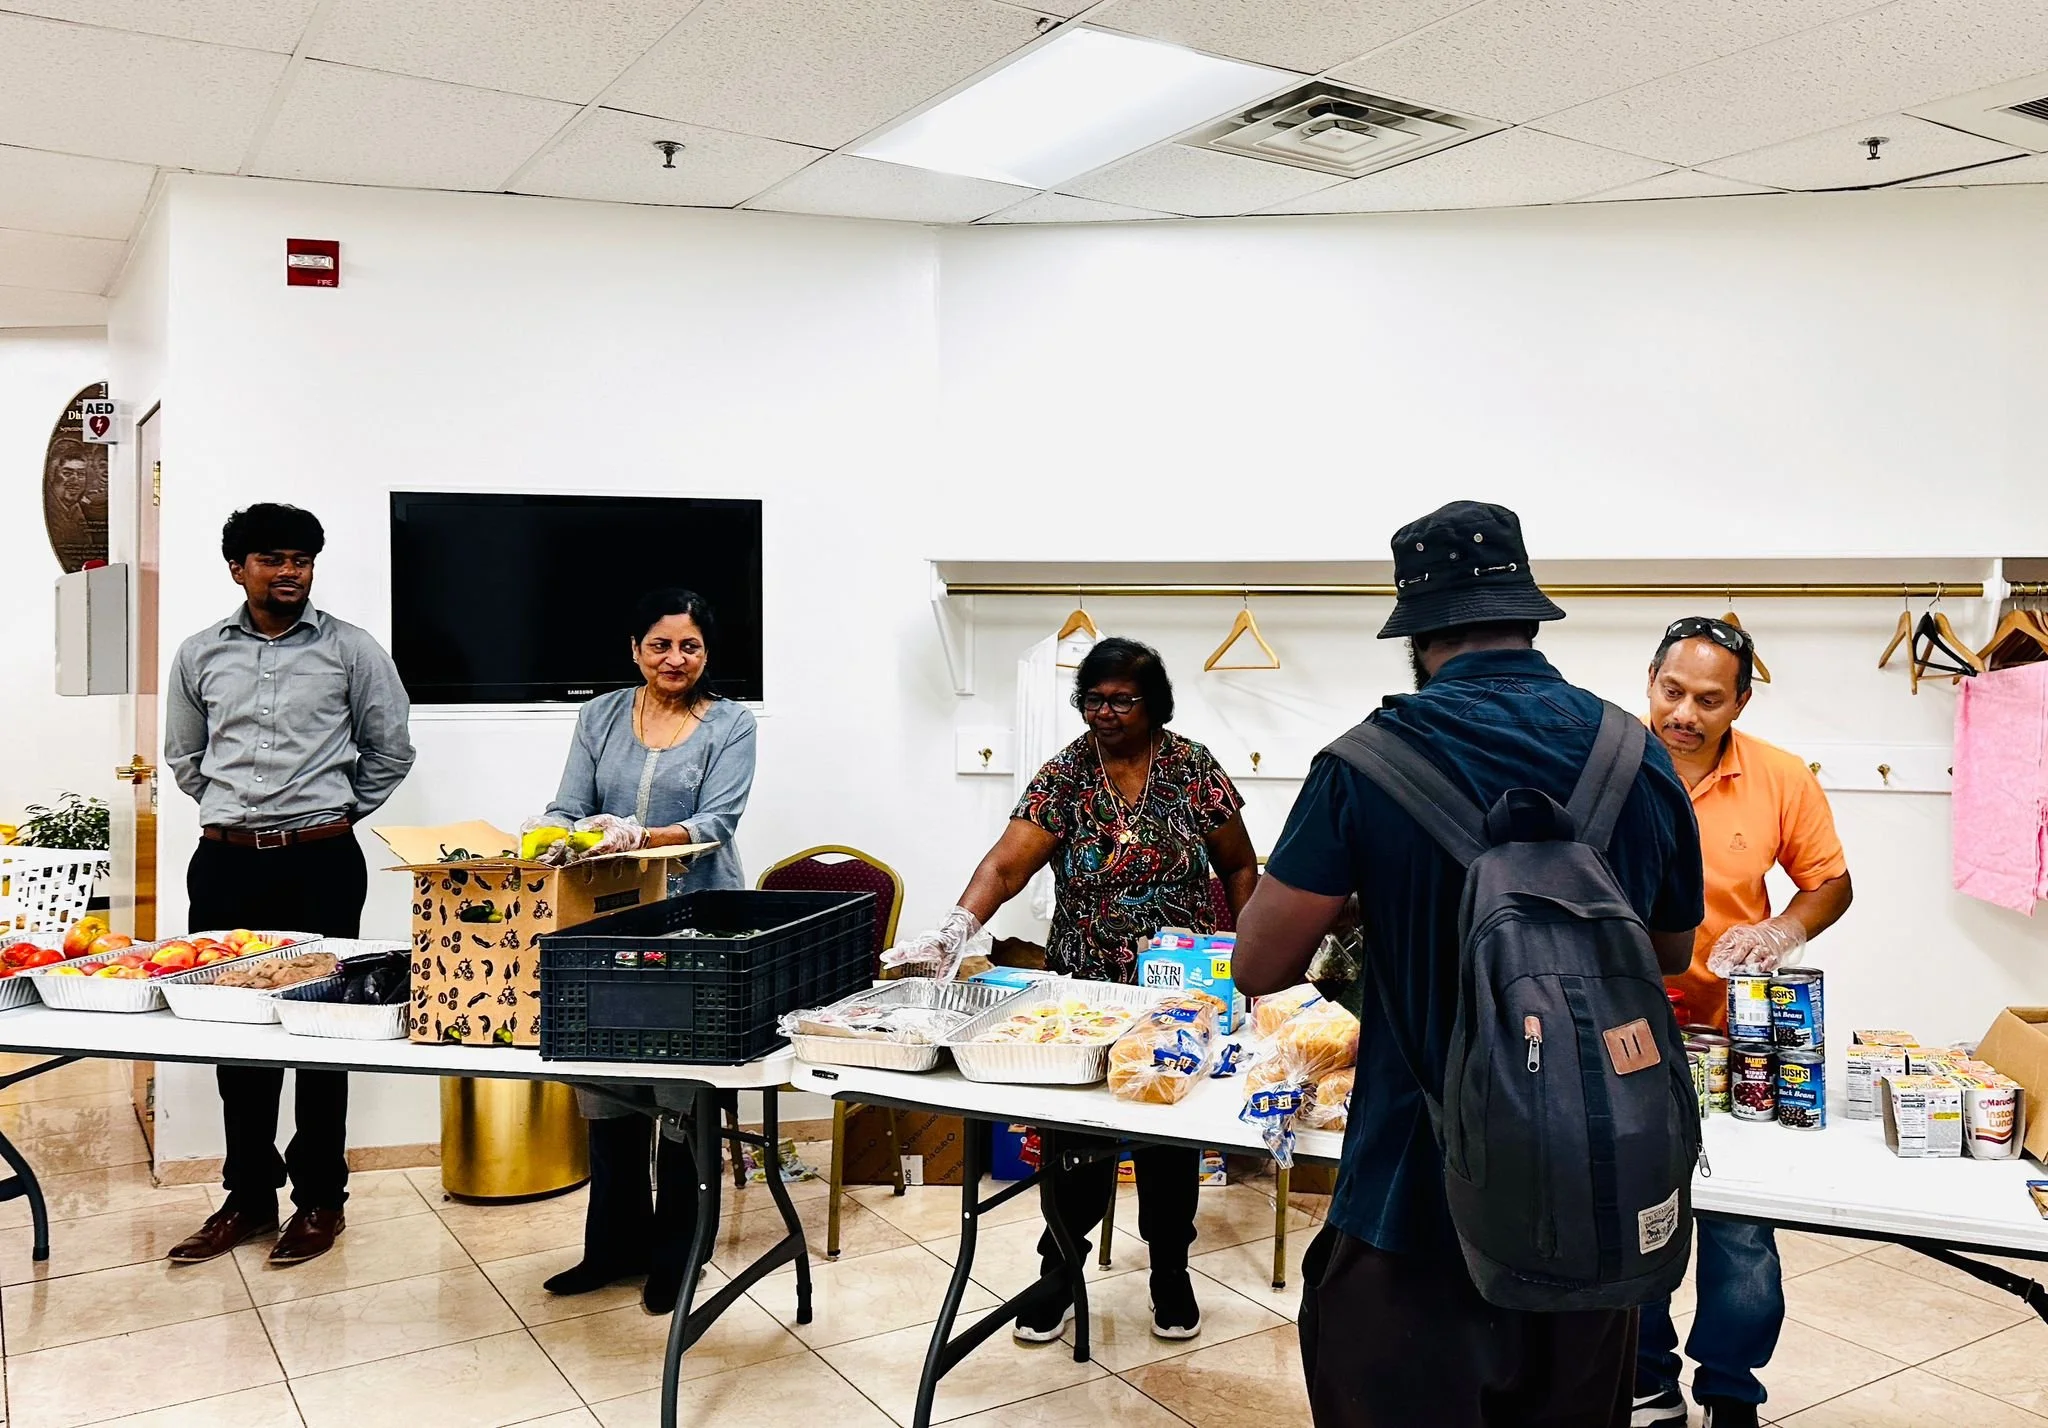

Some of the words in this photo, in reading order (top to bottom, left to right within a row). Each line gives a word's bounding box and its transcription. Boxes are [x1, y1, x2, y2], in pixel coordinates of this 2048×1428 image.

[85, 402, 115, 415] AED
[68, 410, 84, 420] Dhi
[1147, 964, 1181, 975] NUTRI
[1216, 963, 1225, 972] 12
[1147, 975, 1180, 986] GRAIN
[1780, 1066, 1809, 1080] BUSH'S
[1794, 1090, 1815, 1099] Beans
